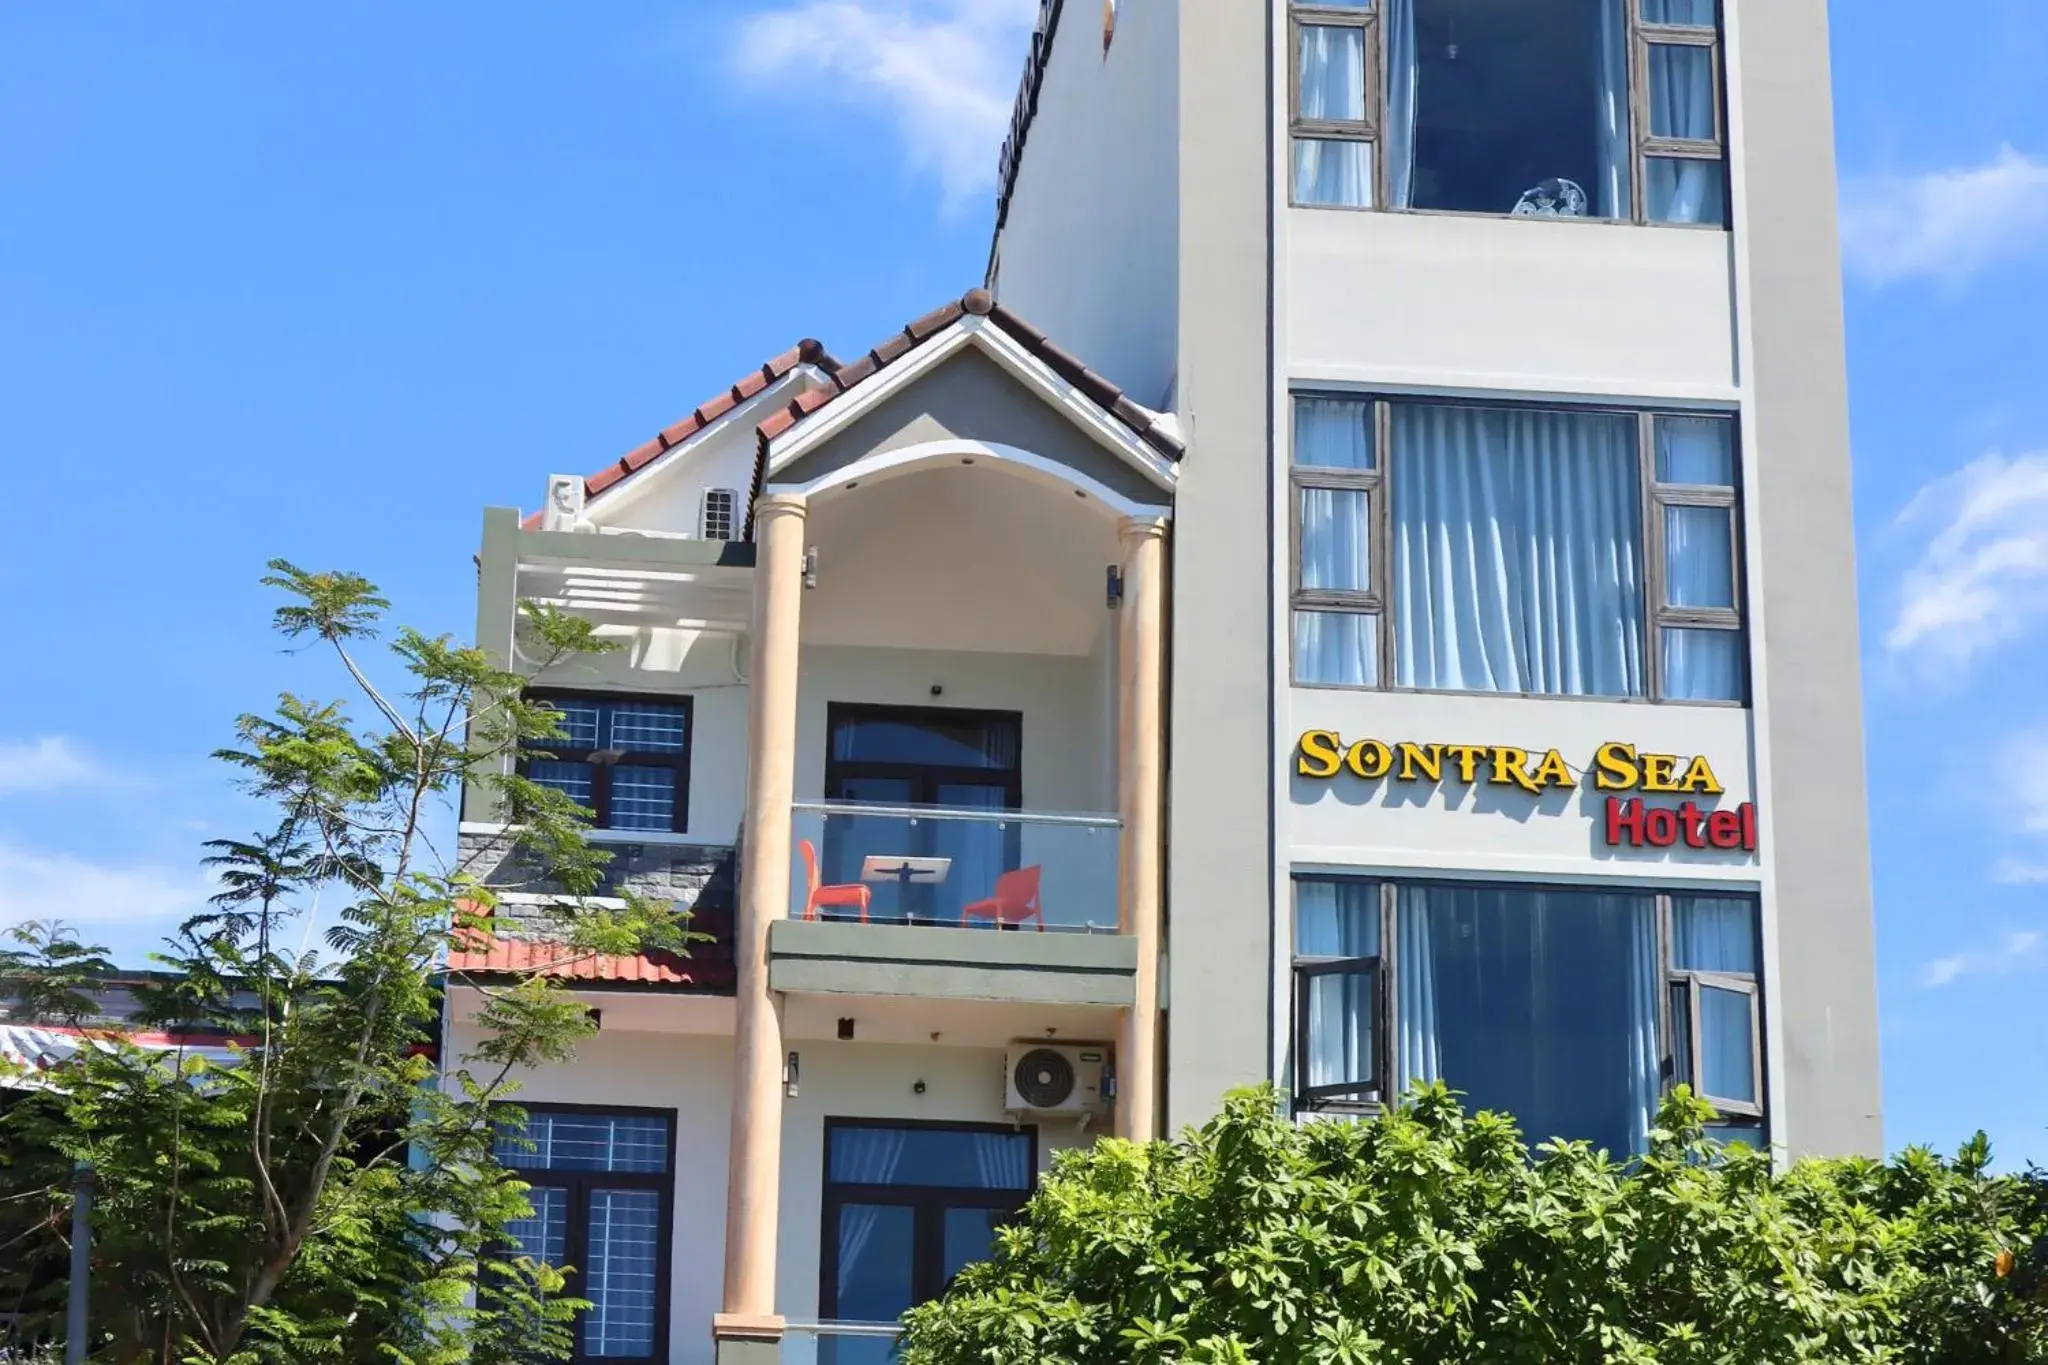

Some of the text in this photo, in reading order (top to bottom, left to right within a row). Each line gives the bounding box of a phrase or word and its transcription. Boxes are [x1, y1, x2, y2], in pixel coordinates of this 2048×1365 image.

[1298, 729, 1724, 794] SONTRA SEA
[1607, 796, 1755, 850] Hotel
